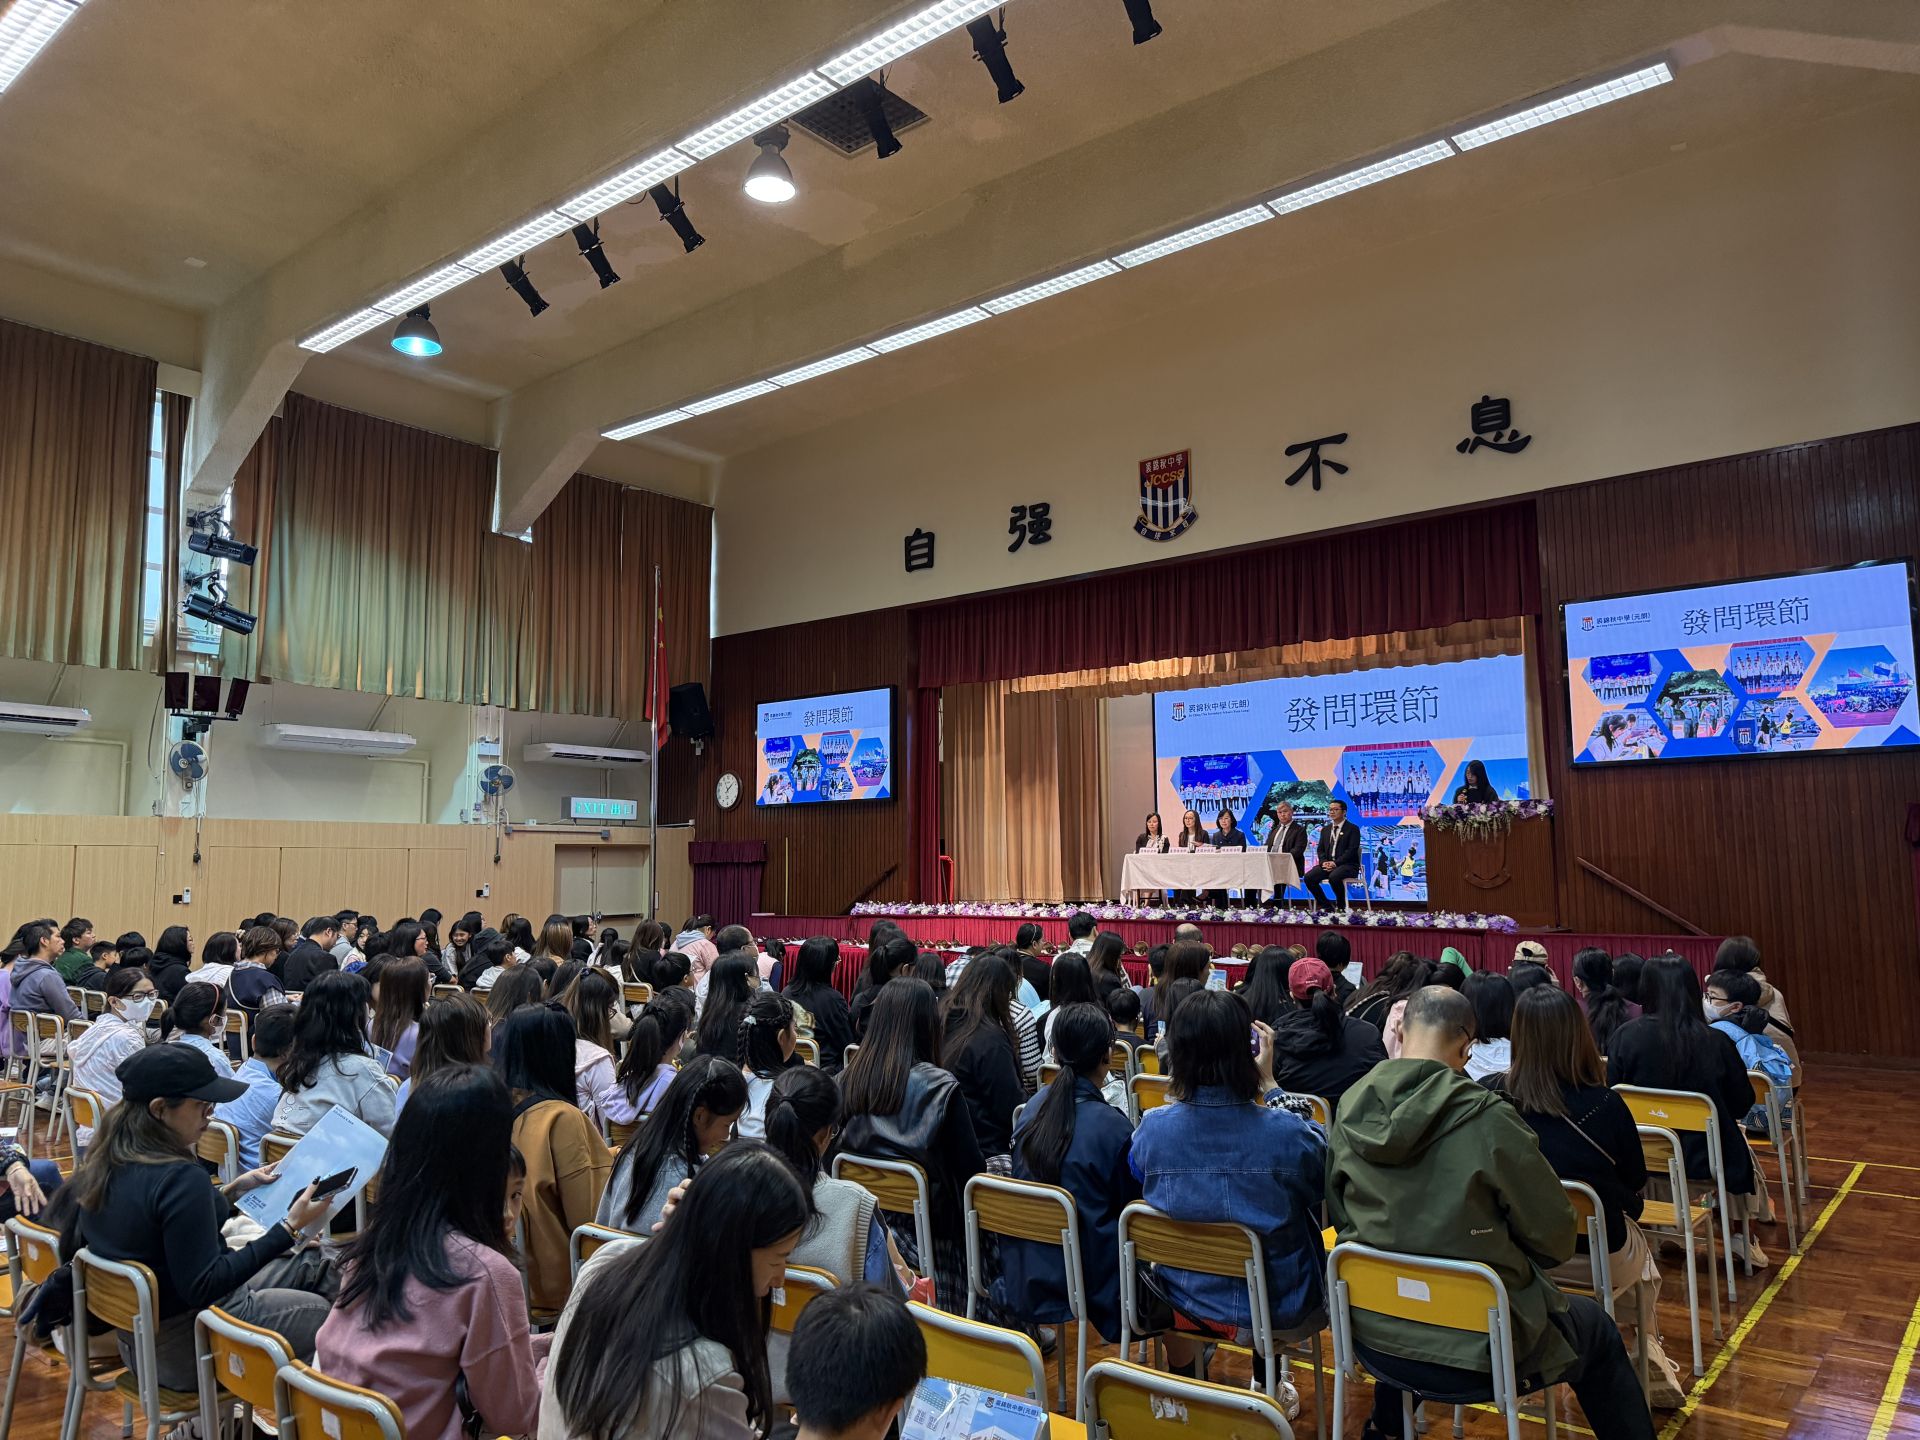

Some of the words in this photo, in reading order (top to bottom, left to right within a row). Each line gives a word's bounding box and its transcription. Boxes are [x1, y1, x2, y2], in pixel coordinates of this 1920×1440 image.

[904, 527, 935, 573] 自
[1284, 432, 1349, 491] 不
[1455, 394, 1532, 454] 息
[1680, 596, 1809, 636] 發問環節
[803, 705, 854, 728] 發問環節
[1284, 685, 1439, 733] 發問環節
[575, 802, 607, 815] EXIT
